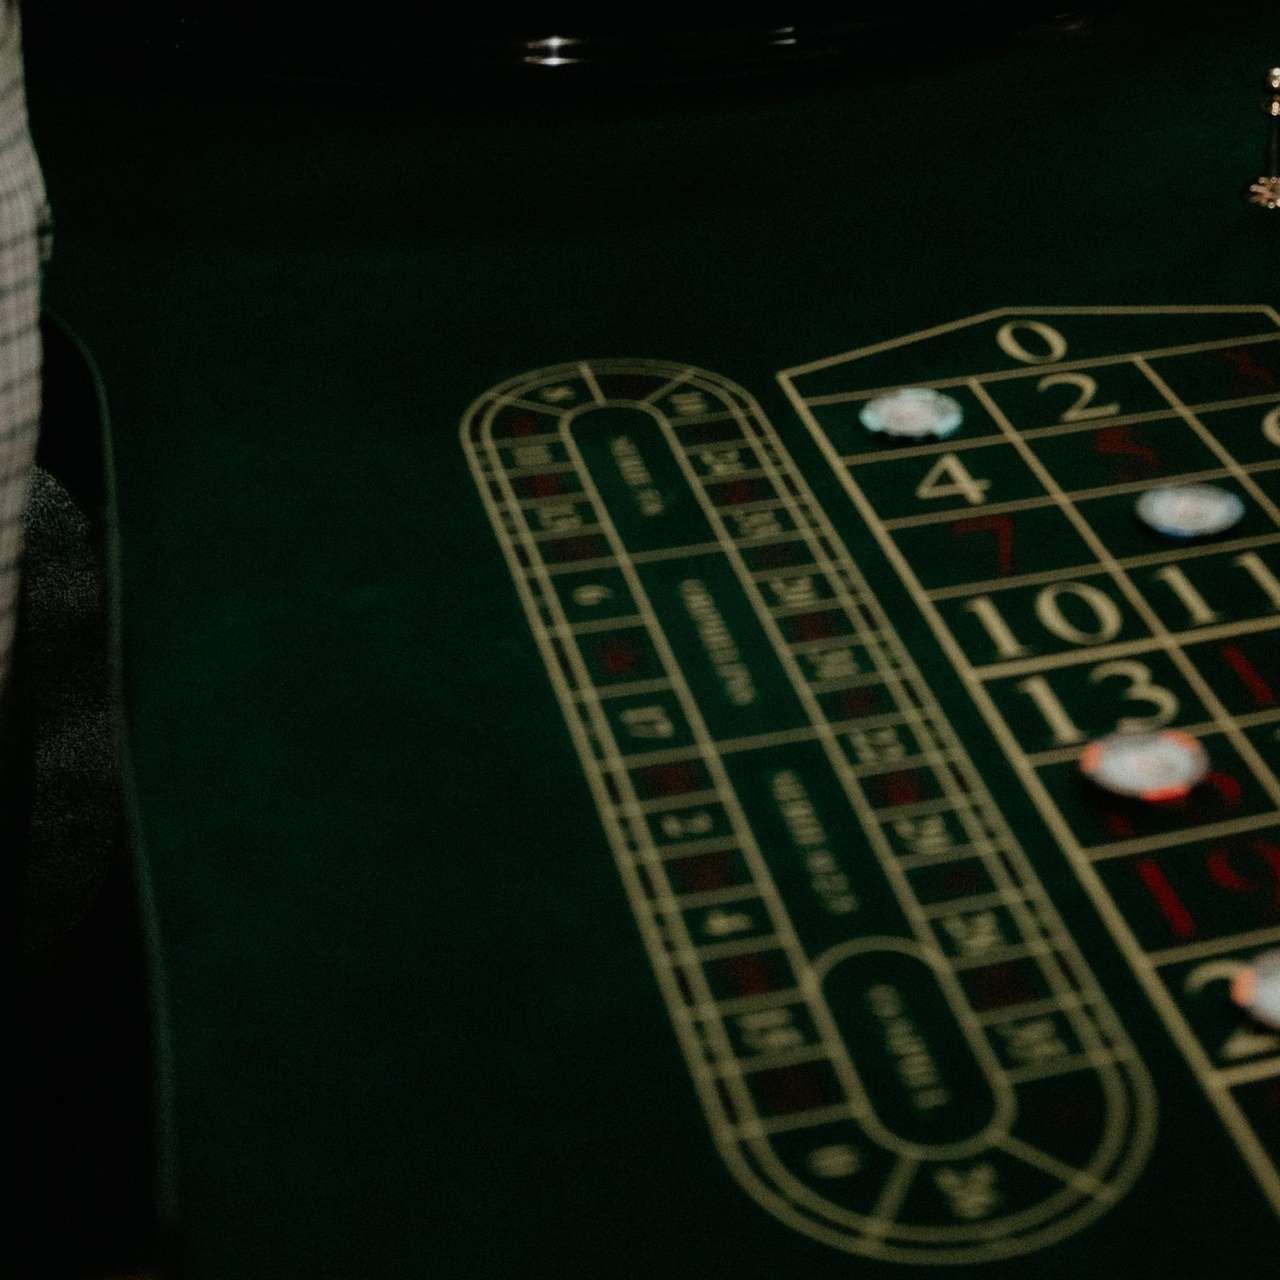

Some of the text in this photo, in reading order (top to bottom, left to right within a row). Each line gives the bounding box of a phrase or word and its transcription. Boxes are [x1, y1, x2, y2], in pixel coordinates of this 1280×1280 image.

[996, 319, 1067, 364] 0
[1037, 372, 1121, 422] 2
[915, 452, 992, 504] 4
[1094, 426, 1160, 482] 5
[948, 514, 1014, 576] 7
[964, 581, 1122, 658] 10
[1017, 659, 1180, 743] 13
